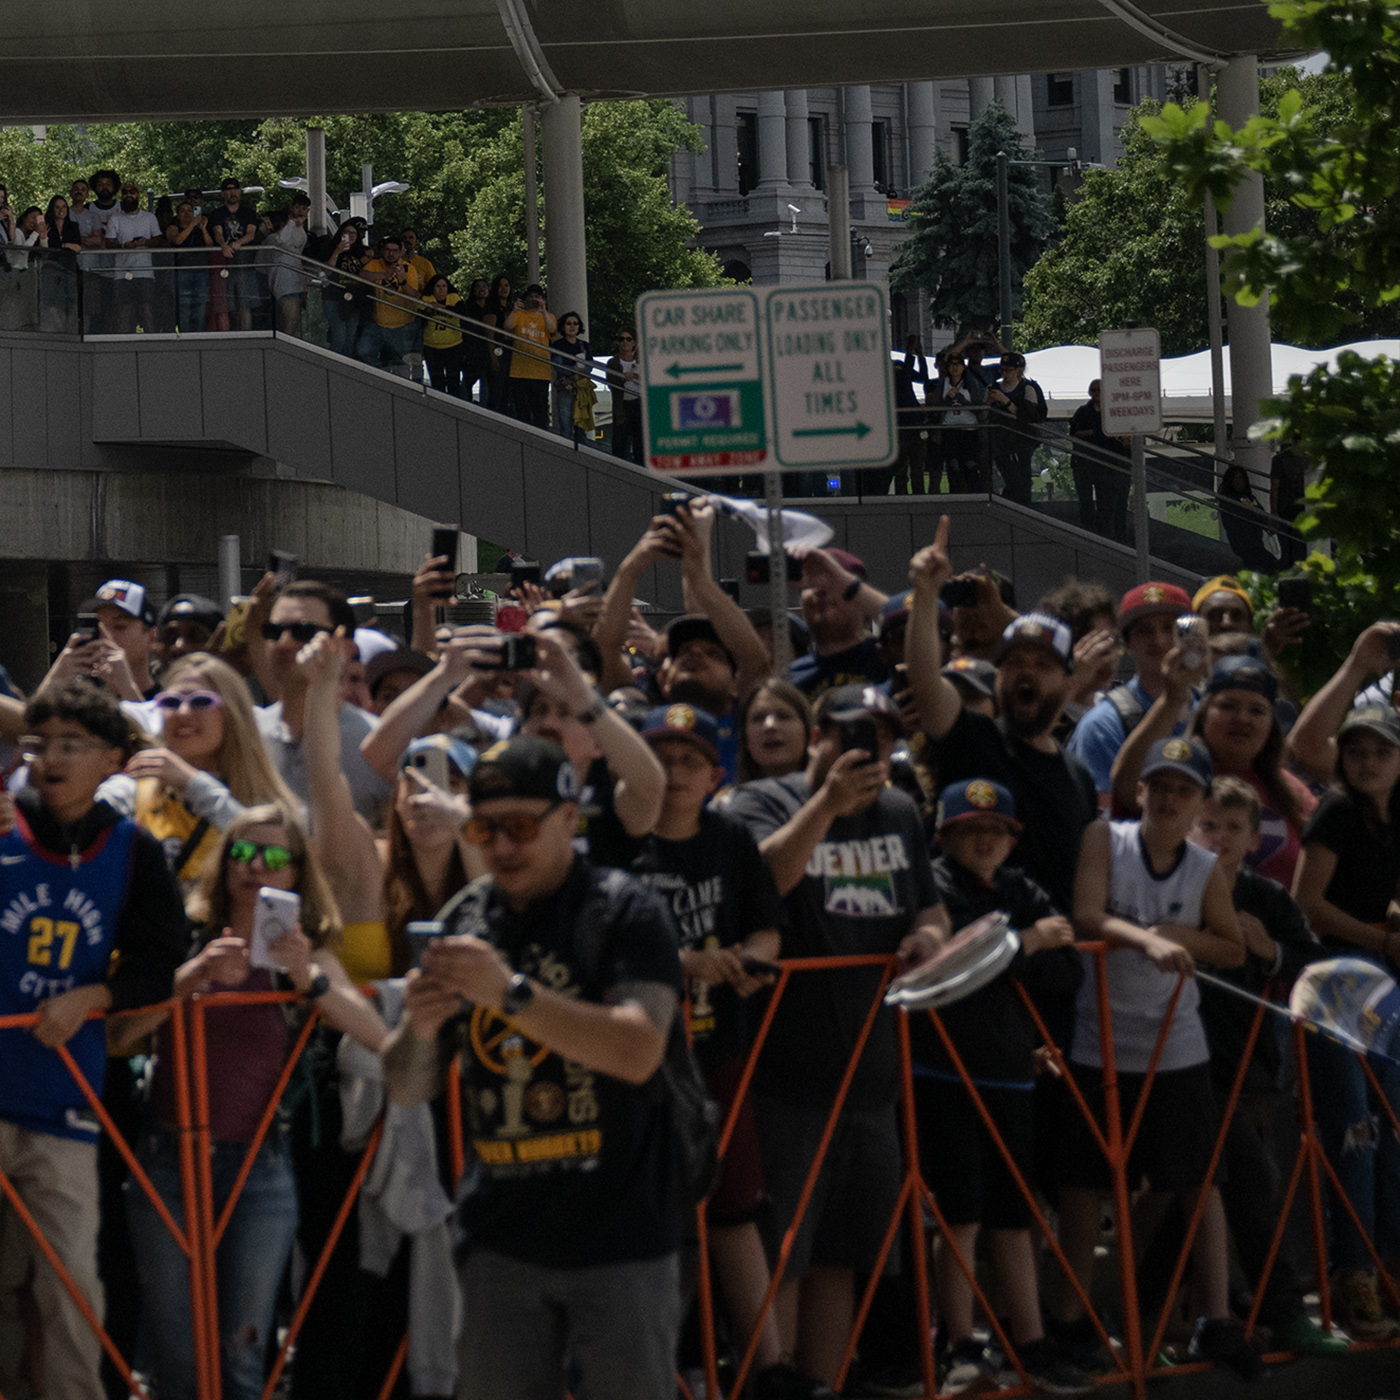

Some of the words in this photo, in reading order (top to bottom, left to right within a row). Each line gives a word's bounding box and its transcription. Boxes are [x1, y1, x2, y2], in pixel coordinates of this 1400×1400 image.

[653, 307, 686, 327] CAR
[691, 302, 746, 324] SHARE
[774, 296, 875, 323] PASSENGER
[649, 332, 712, 355] PARKING
[715, 330, 752, 352] ONLY
[1105, 346, 1154, 359] DISCHARGE
[812, 360, 845, 383] ALL
[1102, 360, 1158, 372] PASSENGERS
[1119, 376, 1142, 387] HERE
[804, 389, 857, 415] TIMES
[1109, 405, 1155, 417] WEEKDAYS
[804, 832, 911, 877] DENVER
[0, 883, 53, 936] MILE
[62, 887, 104, 947] HIGH
[26, 915, 81, 971] 27
